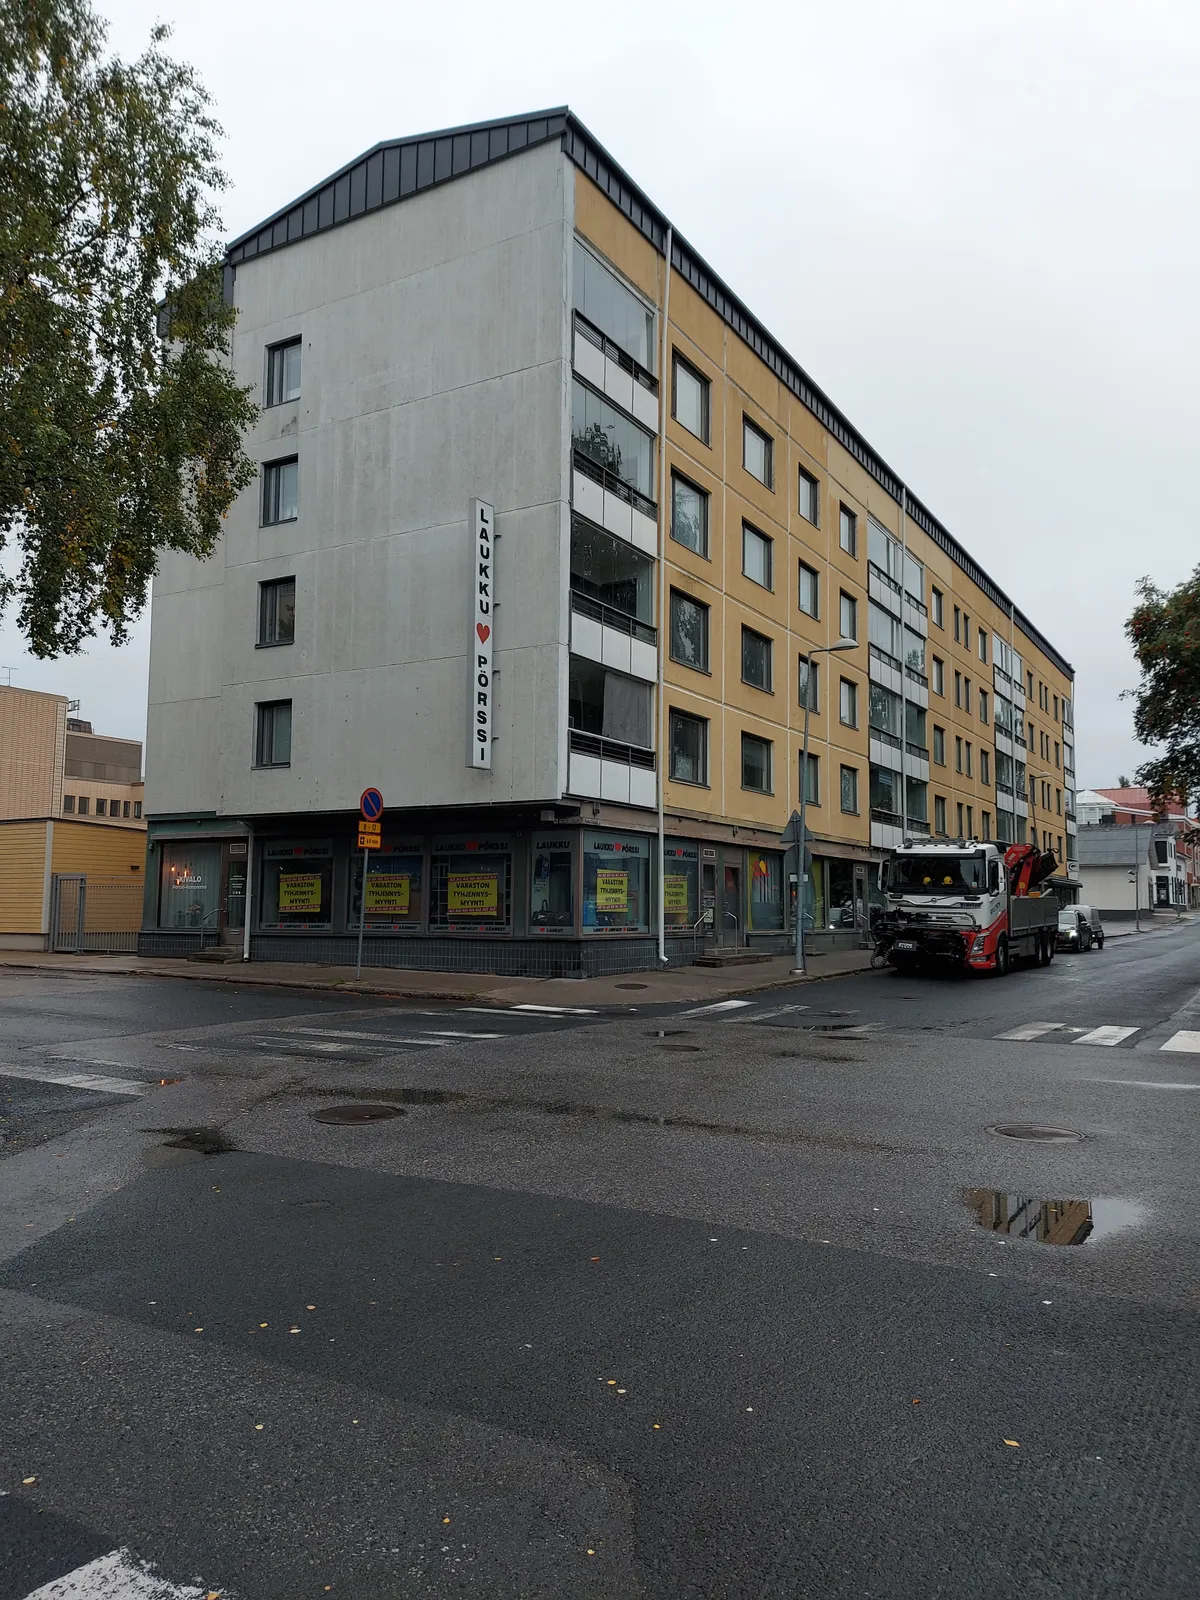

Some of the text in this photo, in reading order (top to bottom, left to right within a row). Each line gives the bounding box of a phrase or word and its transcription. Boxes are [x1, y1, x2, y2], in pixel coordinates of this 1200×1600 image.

[476, 507, 491, 761] LAUKKU PÖRSSI
[435, 840, 508, 852] LAUKKU PÖRSSI
[536, 840, 570, 849] LAUKKU
[594, 842, 614, 852] LAUKKU
[180, 875, 202, 883] KIVALO
